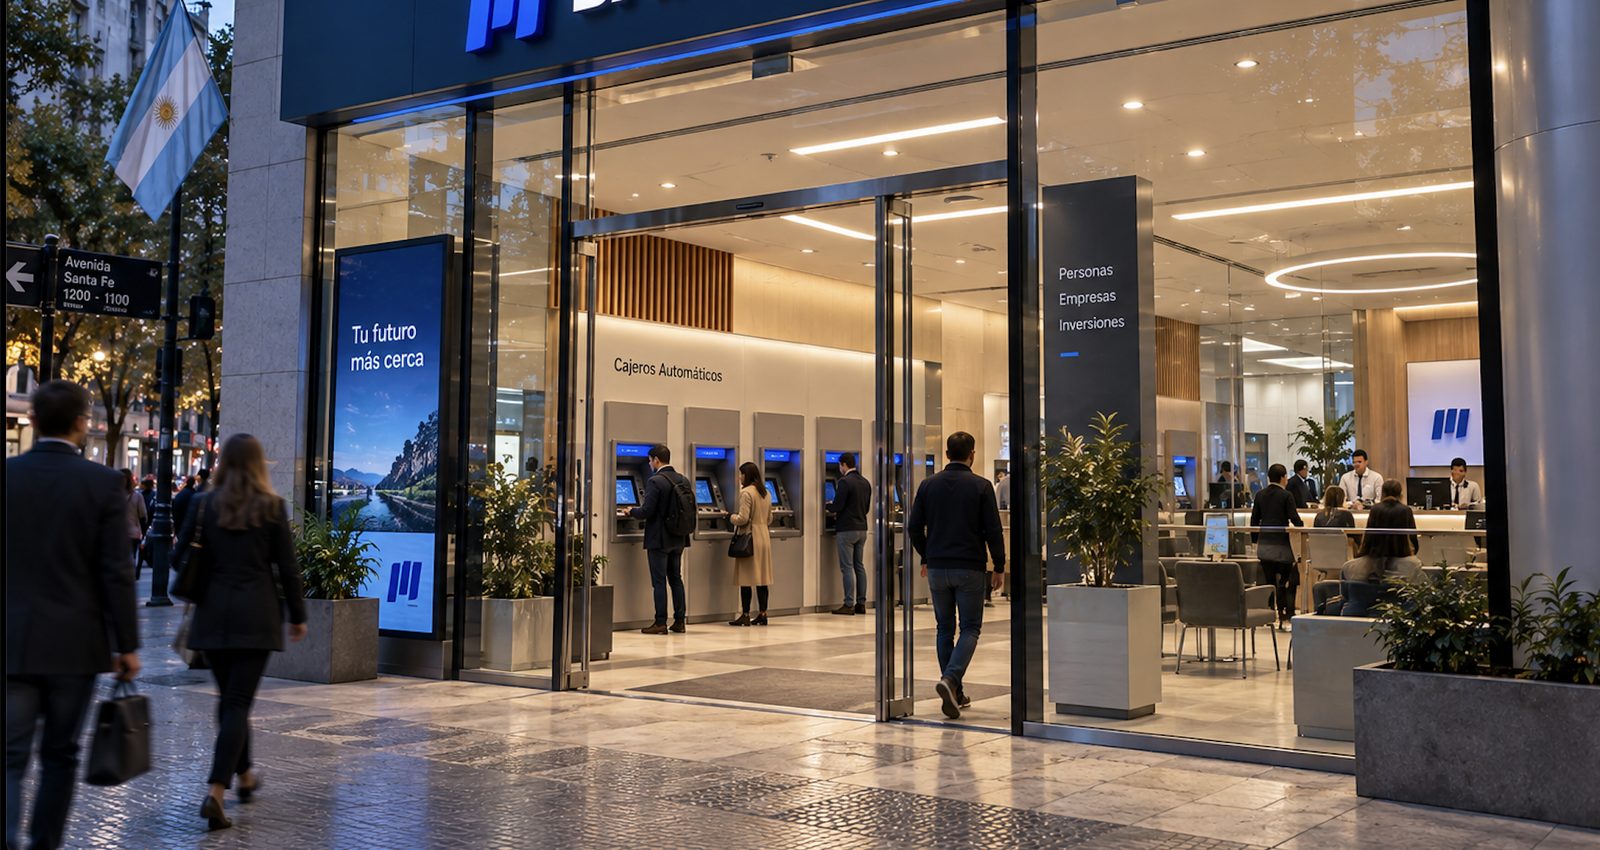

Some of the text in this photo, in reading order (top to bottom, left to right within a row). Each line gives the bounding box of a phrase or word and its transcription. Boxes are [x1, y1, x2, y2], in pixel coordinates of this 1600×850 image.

[64, 256, 111, 272] Avenida
[64, 272, 115, 288] Santa Fe
[1059, 265, 1113, 280] Personas
[63, 288, 91, 302] 1200
[104, 292, 130, 306] 1100
[1059, 291, 1116, 307] Empresas
[1059, 316, 1125, 331] Inversiones
[352, 323, 417, 344] Tu futuro
[351, 350, 424, 371] más cerca
[614, 357, 723, 382] Cajeros Automáticos
